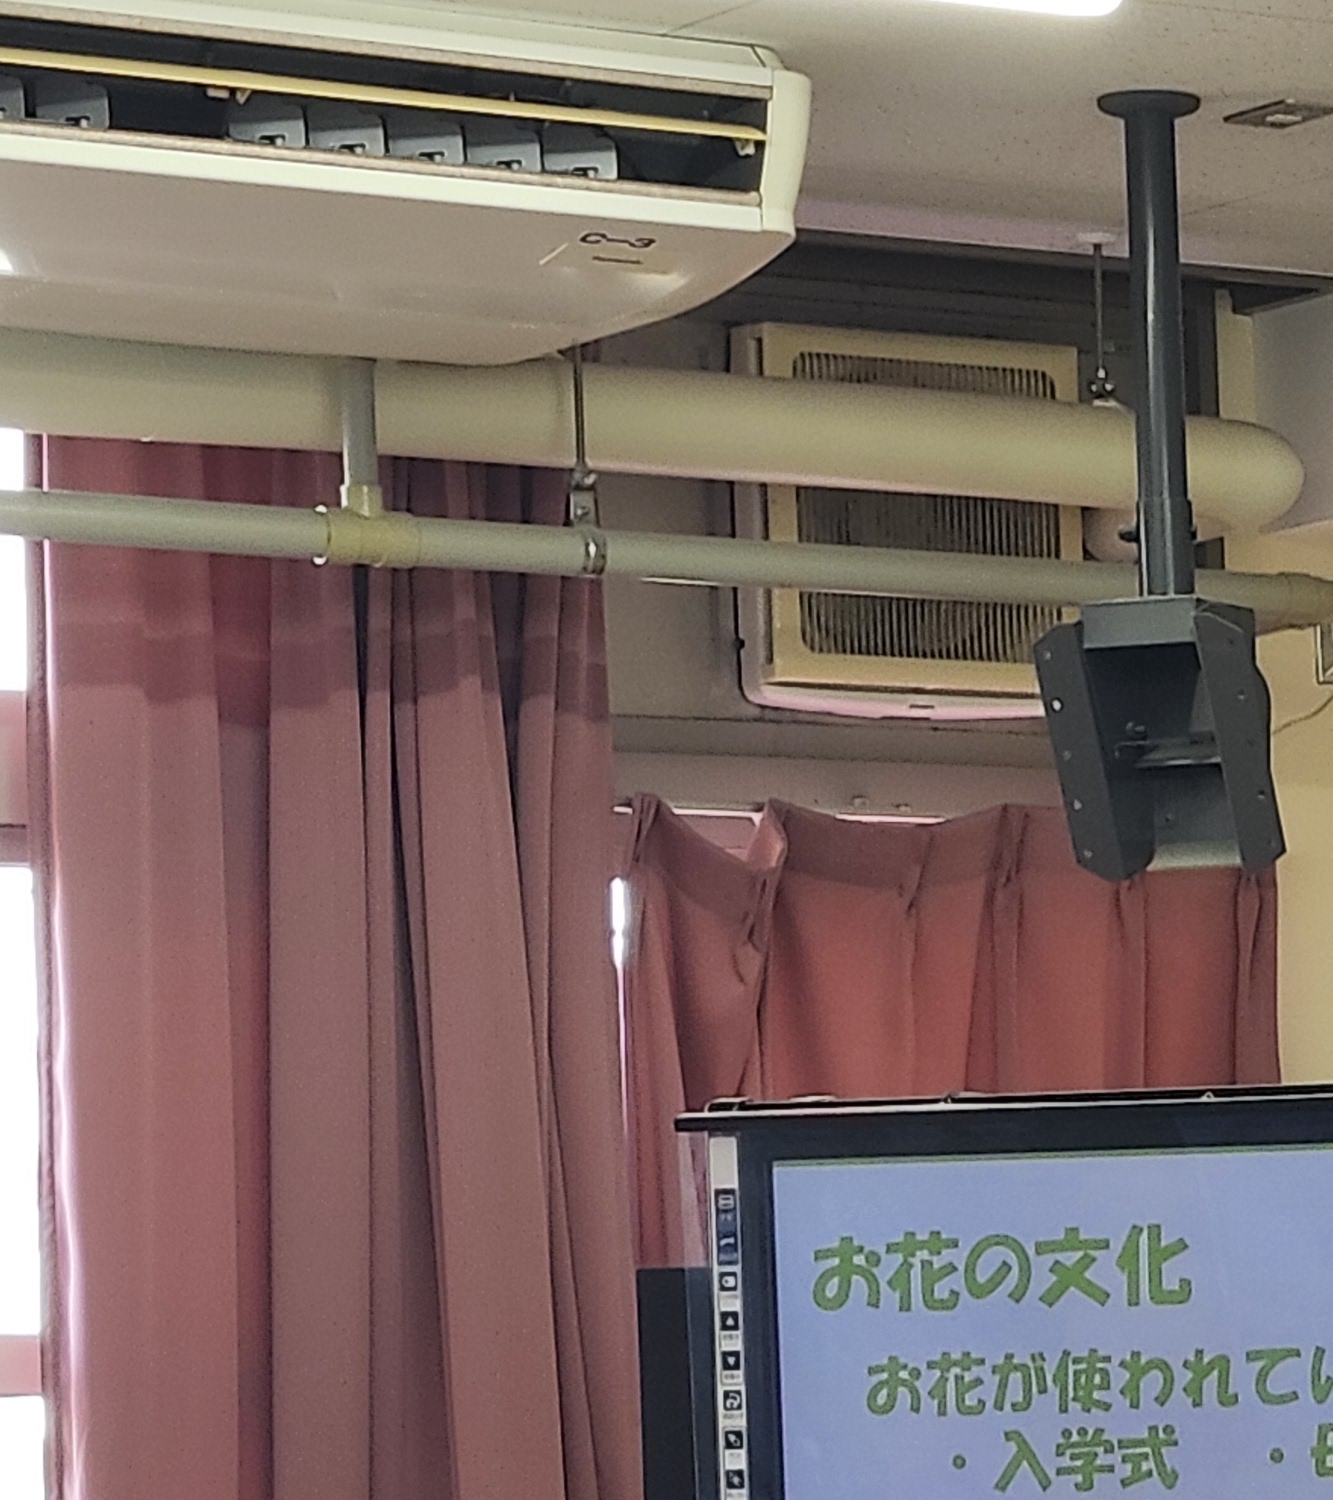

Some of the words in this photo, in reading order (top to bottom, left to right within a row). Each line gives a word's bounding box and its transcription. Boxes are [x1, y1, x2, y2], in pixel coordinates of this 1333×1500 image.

[812, 1224, 1193, 1313] お花の文化
